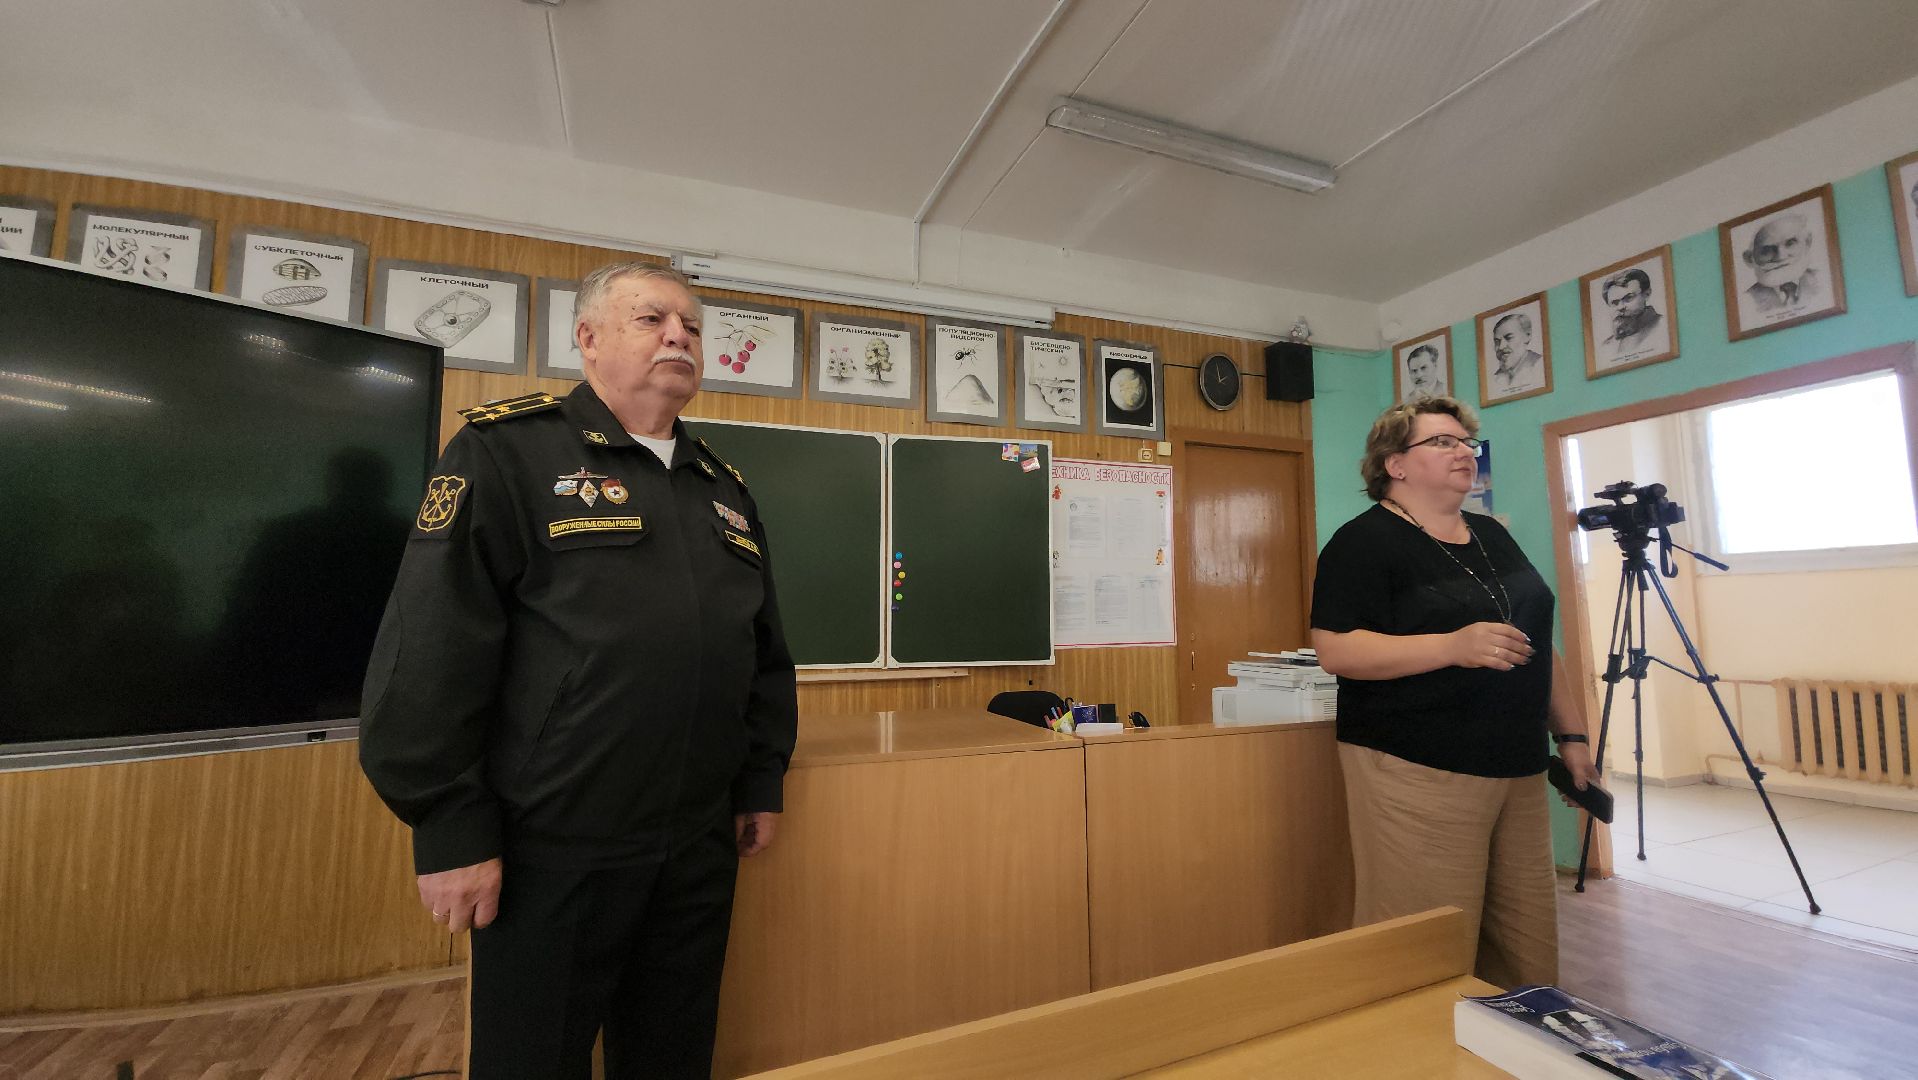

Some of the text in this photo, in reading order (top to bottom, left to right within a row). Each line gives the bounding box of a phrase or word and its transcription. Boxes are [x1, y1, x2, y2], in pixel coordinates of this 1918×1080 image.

[92, 224, 190, 241] МОЛЕКУЛЯРНЫЙ
[254, 245, 344, 261] СУБКЛЕТОЧНЫЙ
[420, 276, 489, 289] КЛЕТОЧНЫЙ
[719, 311, 769, 321] ОРГАННЫЙ
[830, 326, 901, 339] ОРГАНИЗМЕННЫЙ
[1096, 469, 1170, 485] БЕЗОПАСНОСТИ
[551, 519, 640, 533] ВООРУЖЕННЫЕ СИЛЫ РОССИИ
